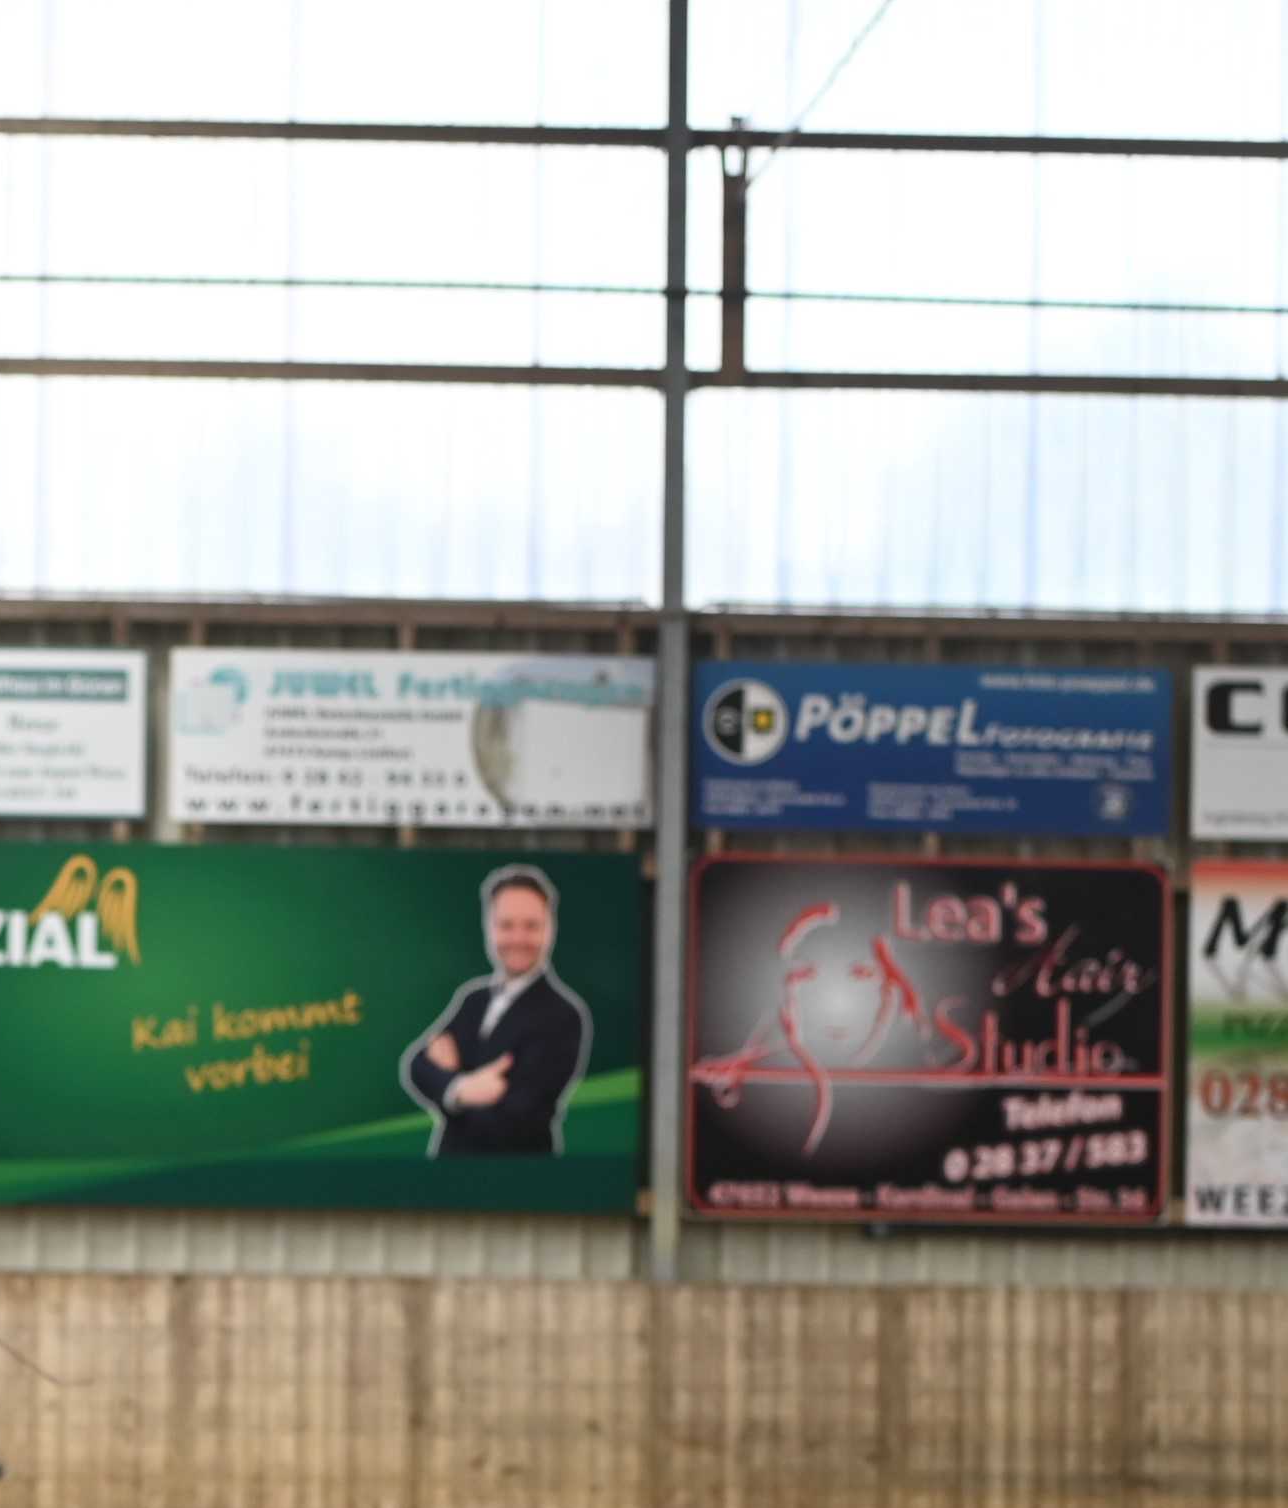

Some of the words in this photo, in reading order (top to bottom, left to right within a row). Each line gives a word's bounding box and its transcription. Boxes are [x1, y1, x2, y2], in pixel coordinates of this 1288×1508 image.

[793, 692, 981, 746] PÖPPEL
[1205, 678, 1288, 737] C
[891, 878, 1048, 943] Lea's
[131, 1006, 198, 1054] Kai
[213, 992, 364, 1043] kommt
[931, 996, 1127, 1074] Studio
[184, 1040, 313, 1094] vorbei
[1002, 1090, 1123, 1130] Telefon
[1194, 1185, 1288, 1214] WEE
